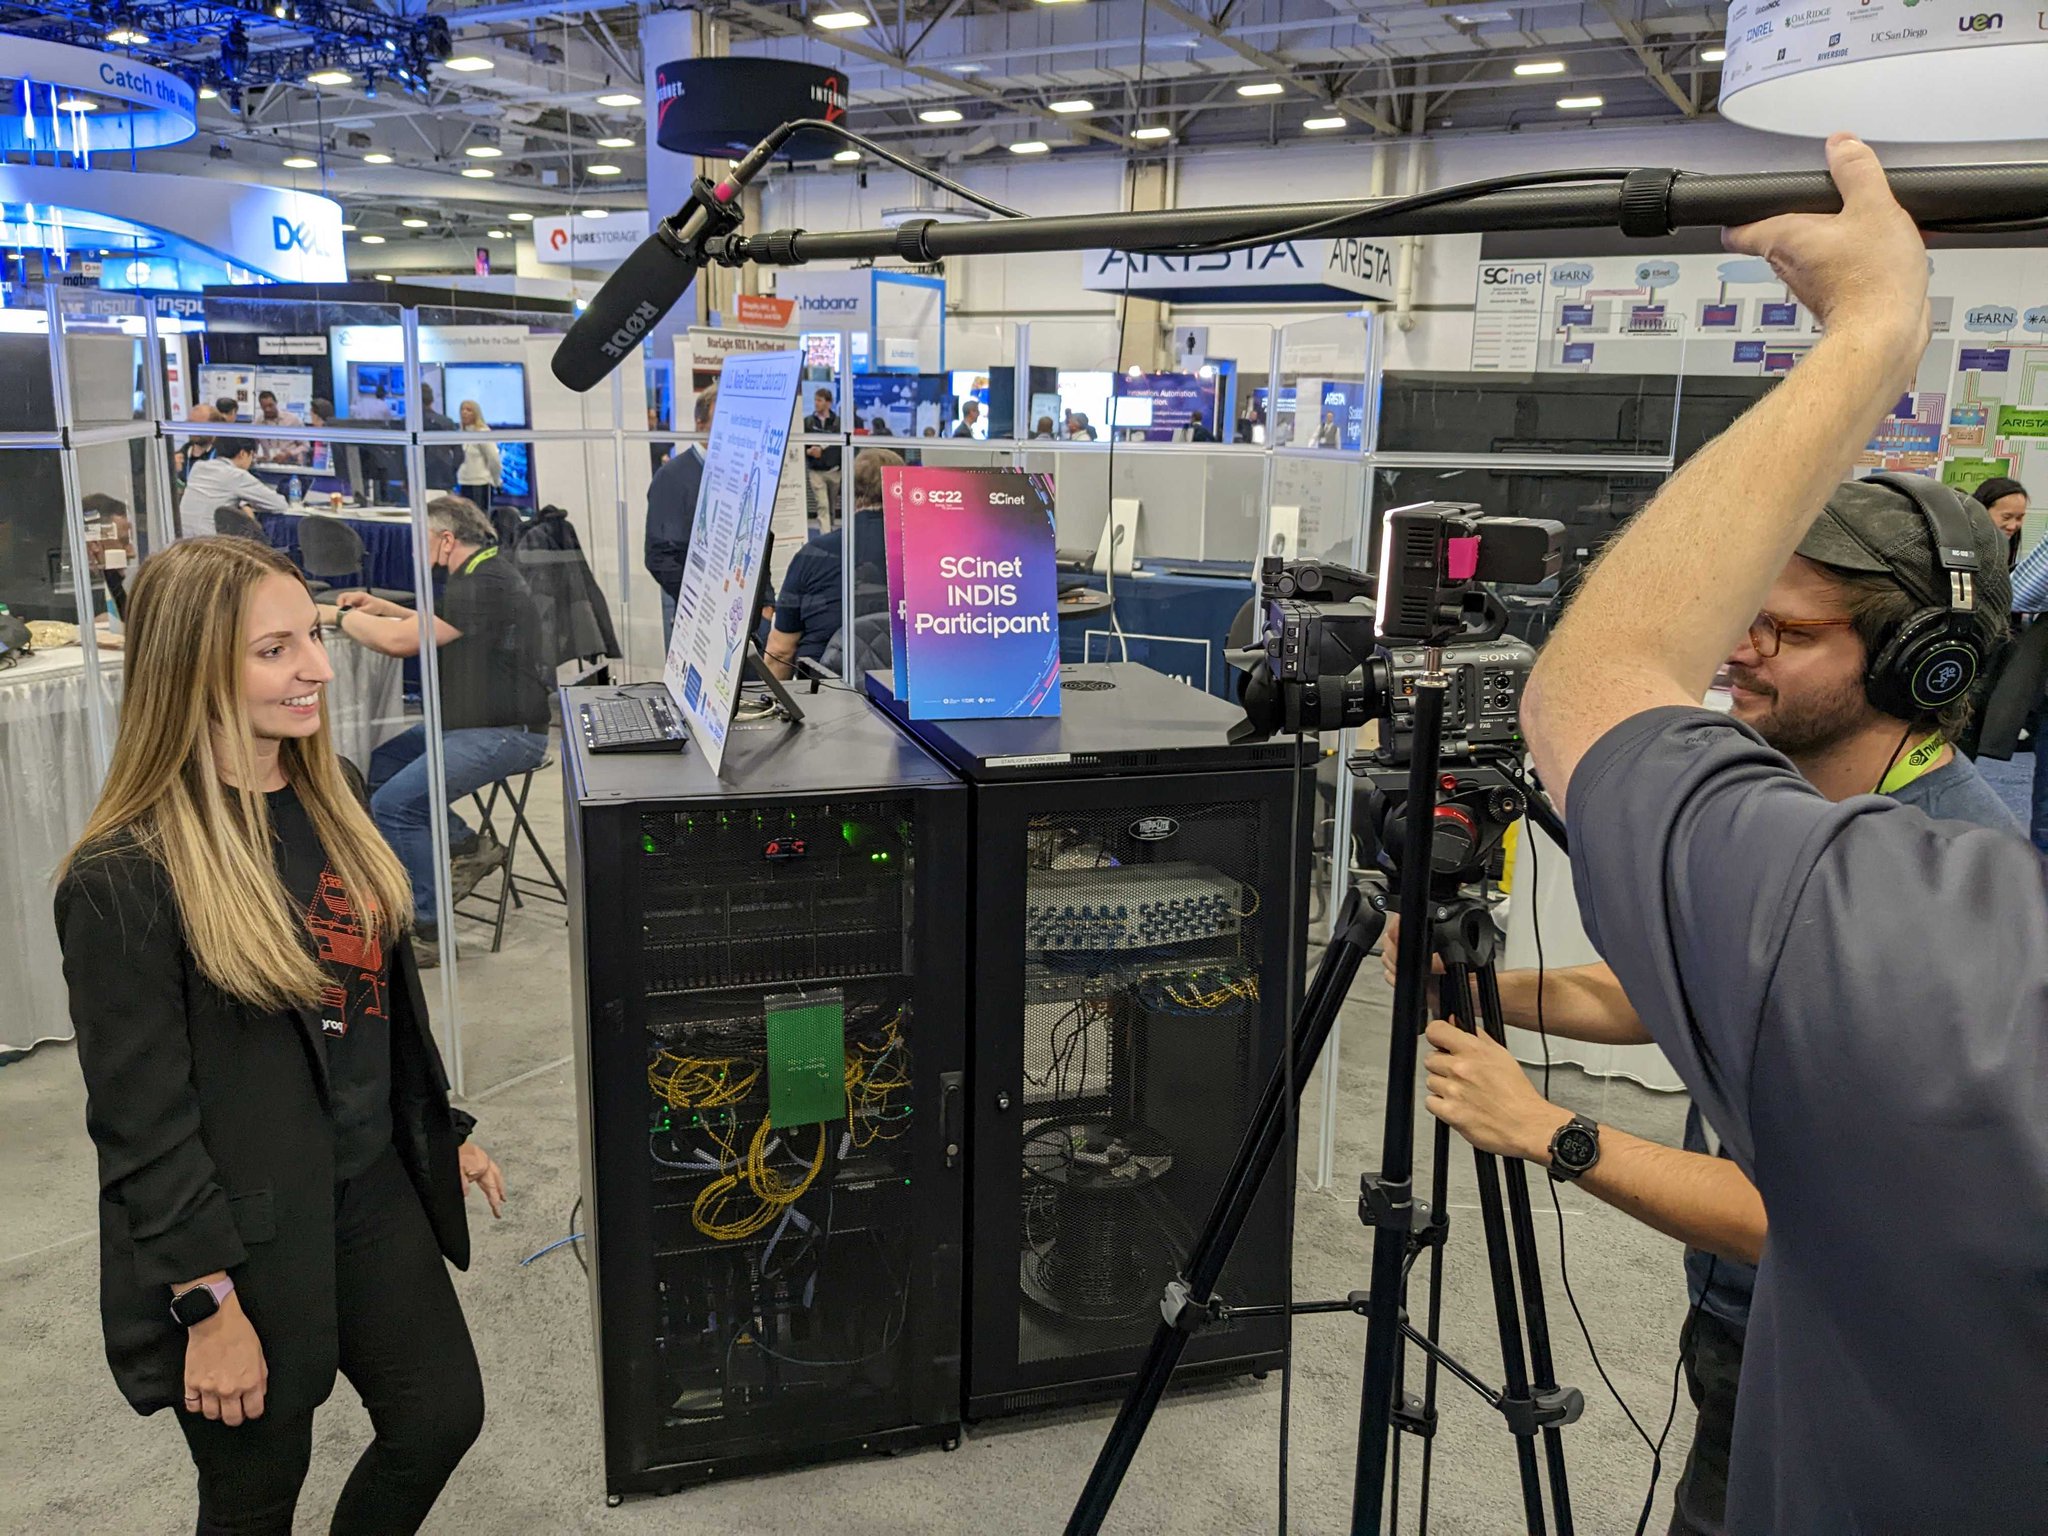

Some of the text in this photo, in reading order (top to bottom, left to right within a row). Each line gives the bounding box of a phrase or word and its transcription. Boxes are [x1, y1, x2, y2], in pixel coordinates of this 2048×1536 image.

[1791, 7, 1832, 24] OAK RIDGE
[1959, 13, 2003, 31] uen
[1752, 20, 1774, 38] NREL
[1871, 28, 1928, 42] UC San Diego
[1817, 48, 1848, 61] RIVERSIDE
[100, 63, 152, 94] Catch
[156, 80, 175, 103] the
[1329, 238, 1393, 286] ARISTA
[1483, 267, 1543, 284] SCinet
[1553, 269, 1591, 281] LEARN
[803, 295, 859, 310] habana
[1968, 312, 2015, 324] LEARN
[928, 490, 963, 503] SC22
[988, 492, 1026, 506] SCinet
[939, 556, 1023, 578] SCinet
[947, 584, 1018, 607] INDIS
[914, 611, 1051, 639] Participant
[1479, 652, 1520, 662] SONY
